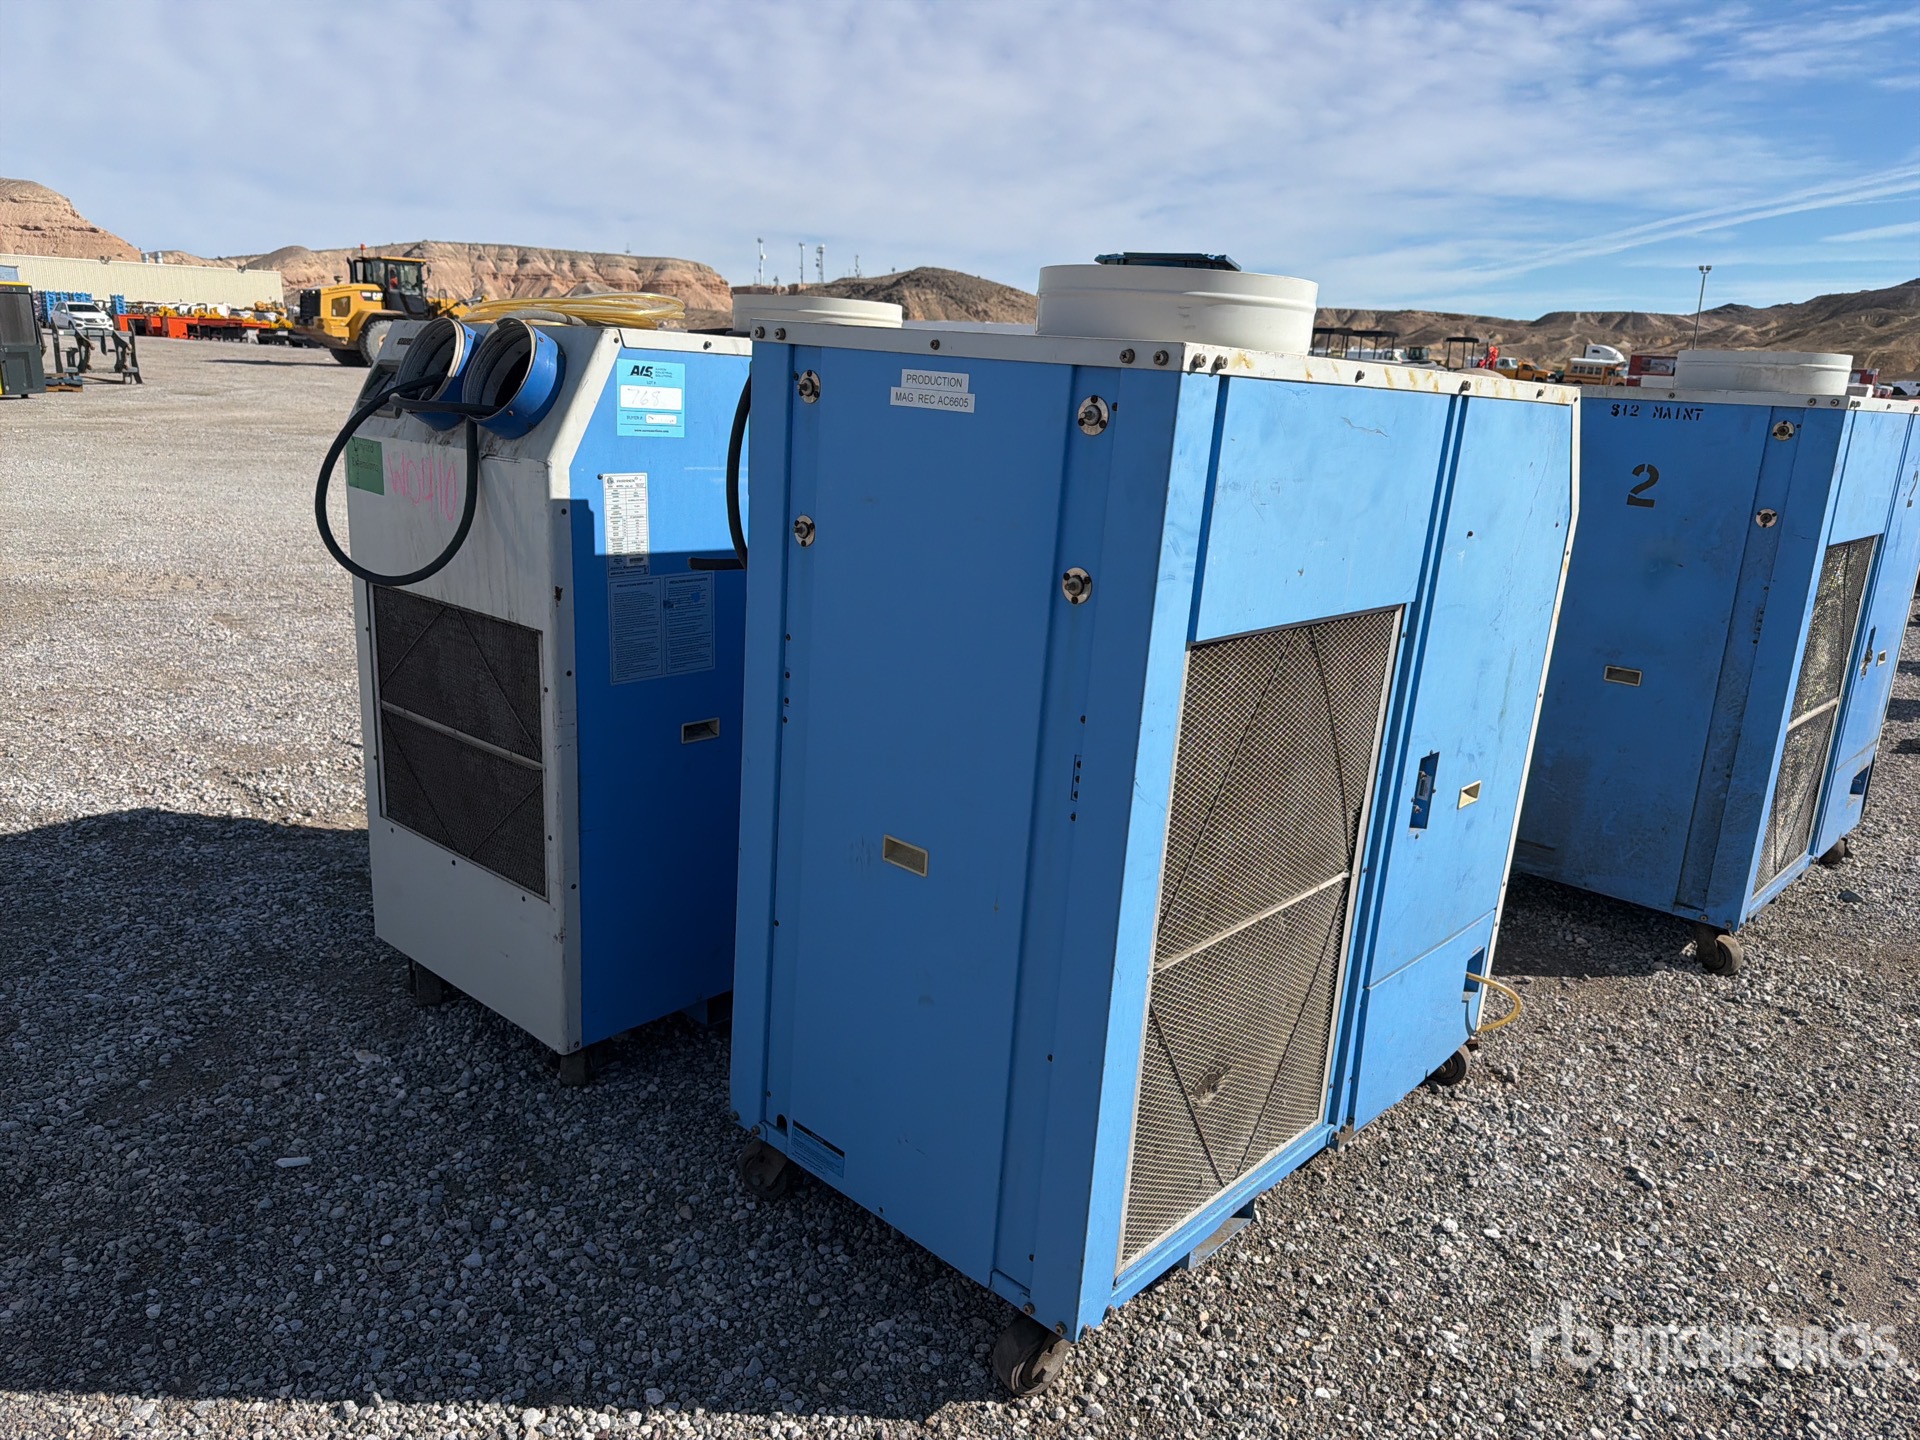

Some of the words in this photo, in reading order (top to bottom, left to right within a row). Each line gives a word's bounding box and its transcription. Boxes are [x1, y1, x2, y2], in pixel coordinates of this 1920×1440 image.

[628, 365, 654, 379] AIS
[906, 373, 963, 388] PRODUCTION
[895, 391, 914, 402] MAG
[918, 393, 936, 404] REC
[937, 395, 969, 408] AC6605
[1652, 406, 1704, 421] MAINT
[1626, 463, 1659, 508] 2
